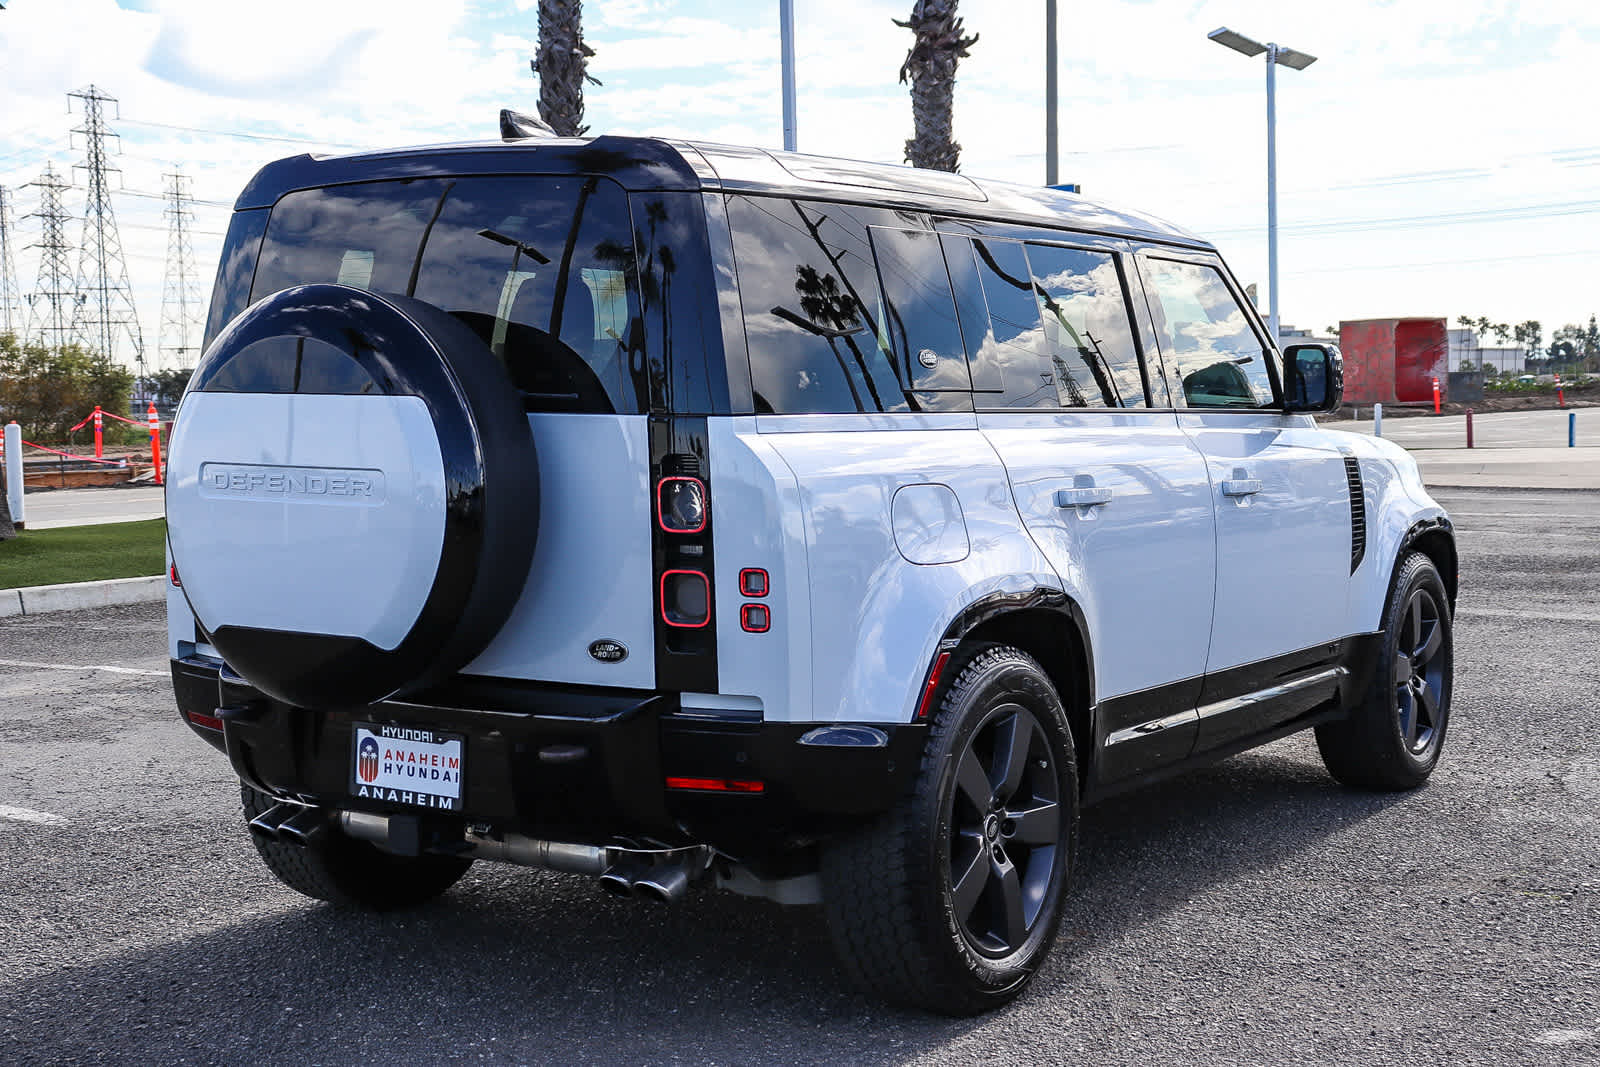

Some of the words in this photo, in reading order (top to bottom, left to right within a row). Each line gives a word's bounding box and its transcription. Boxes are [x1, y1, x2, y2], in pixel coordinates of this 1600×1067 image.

[214, 471, 372, 496] DEFENDER
[382, 726, 433, 743] HYUNDAI
[384, 749, 459, 769] ANAHEIM
[384, 763, 459, 783] HYUNDAI
[358, 786, 453, 810] ANAHEIM
